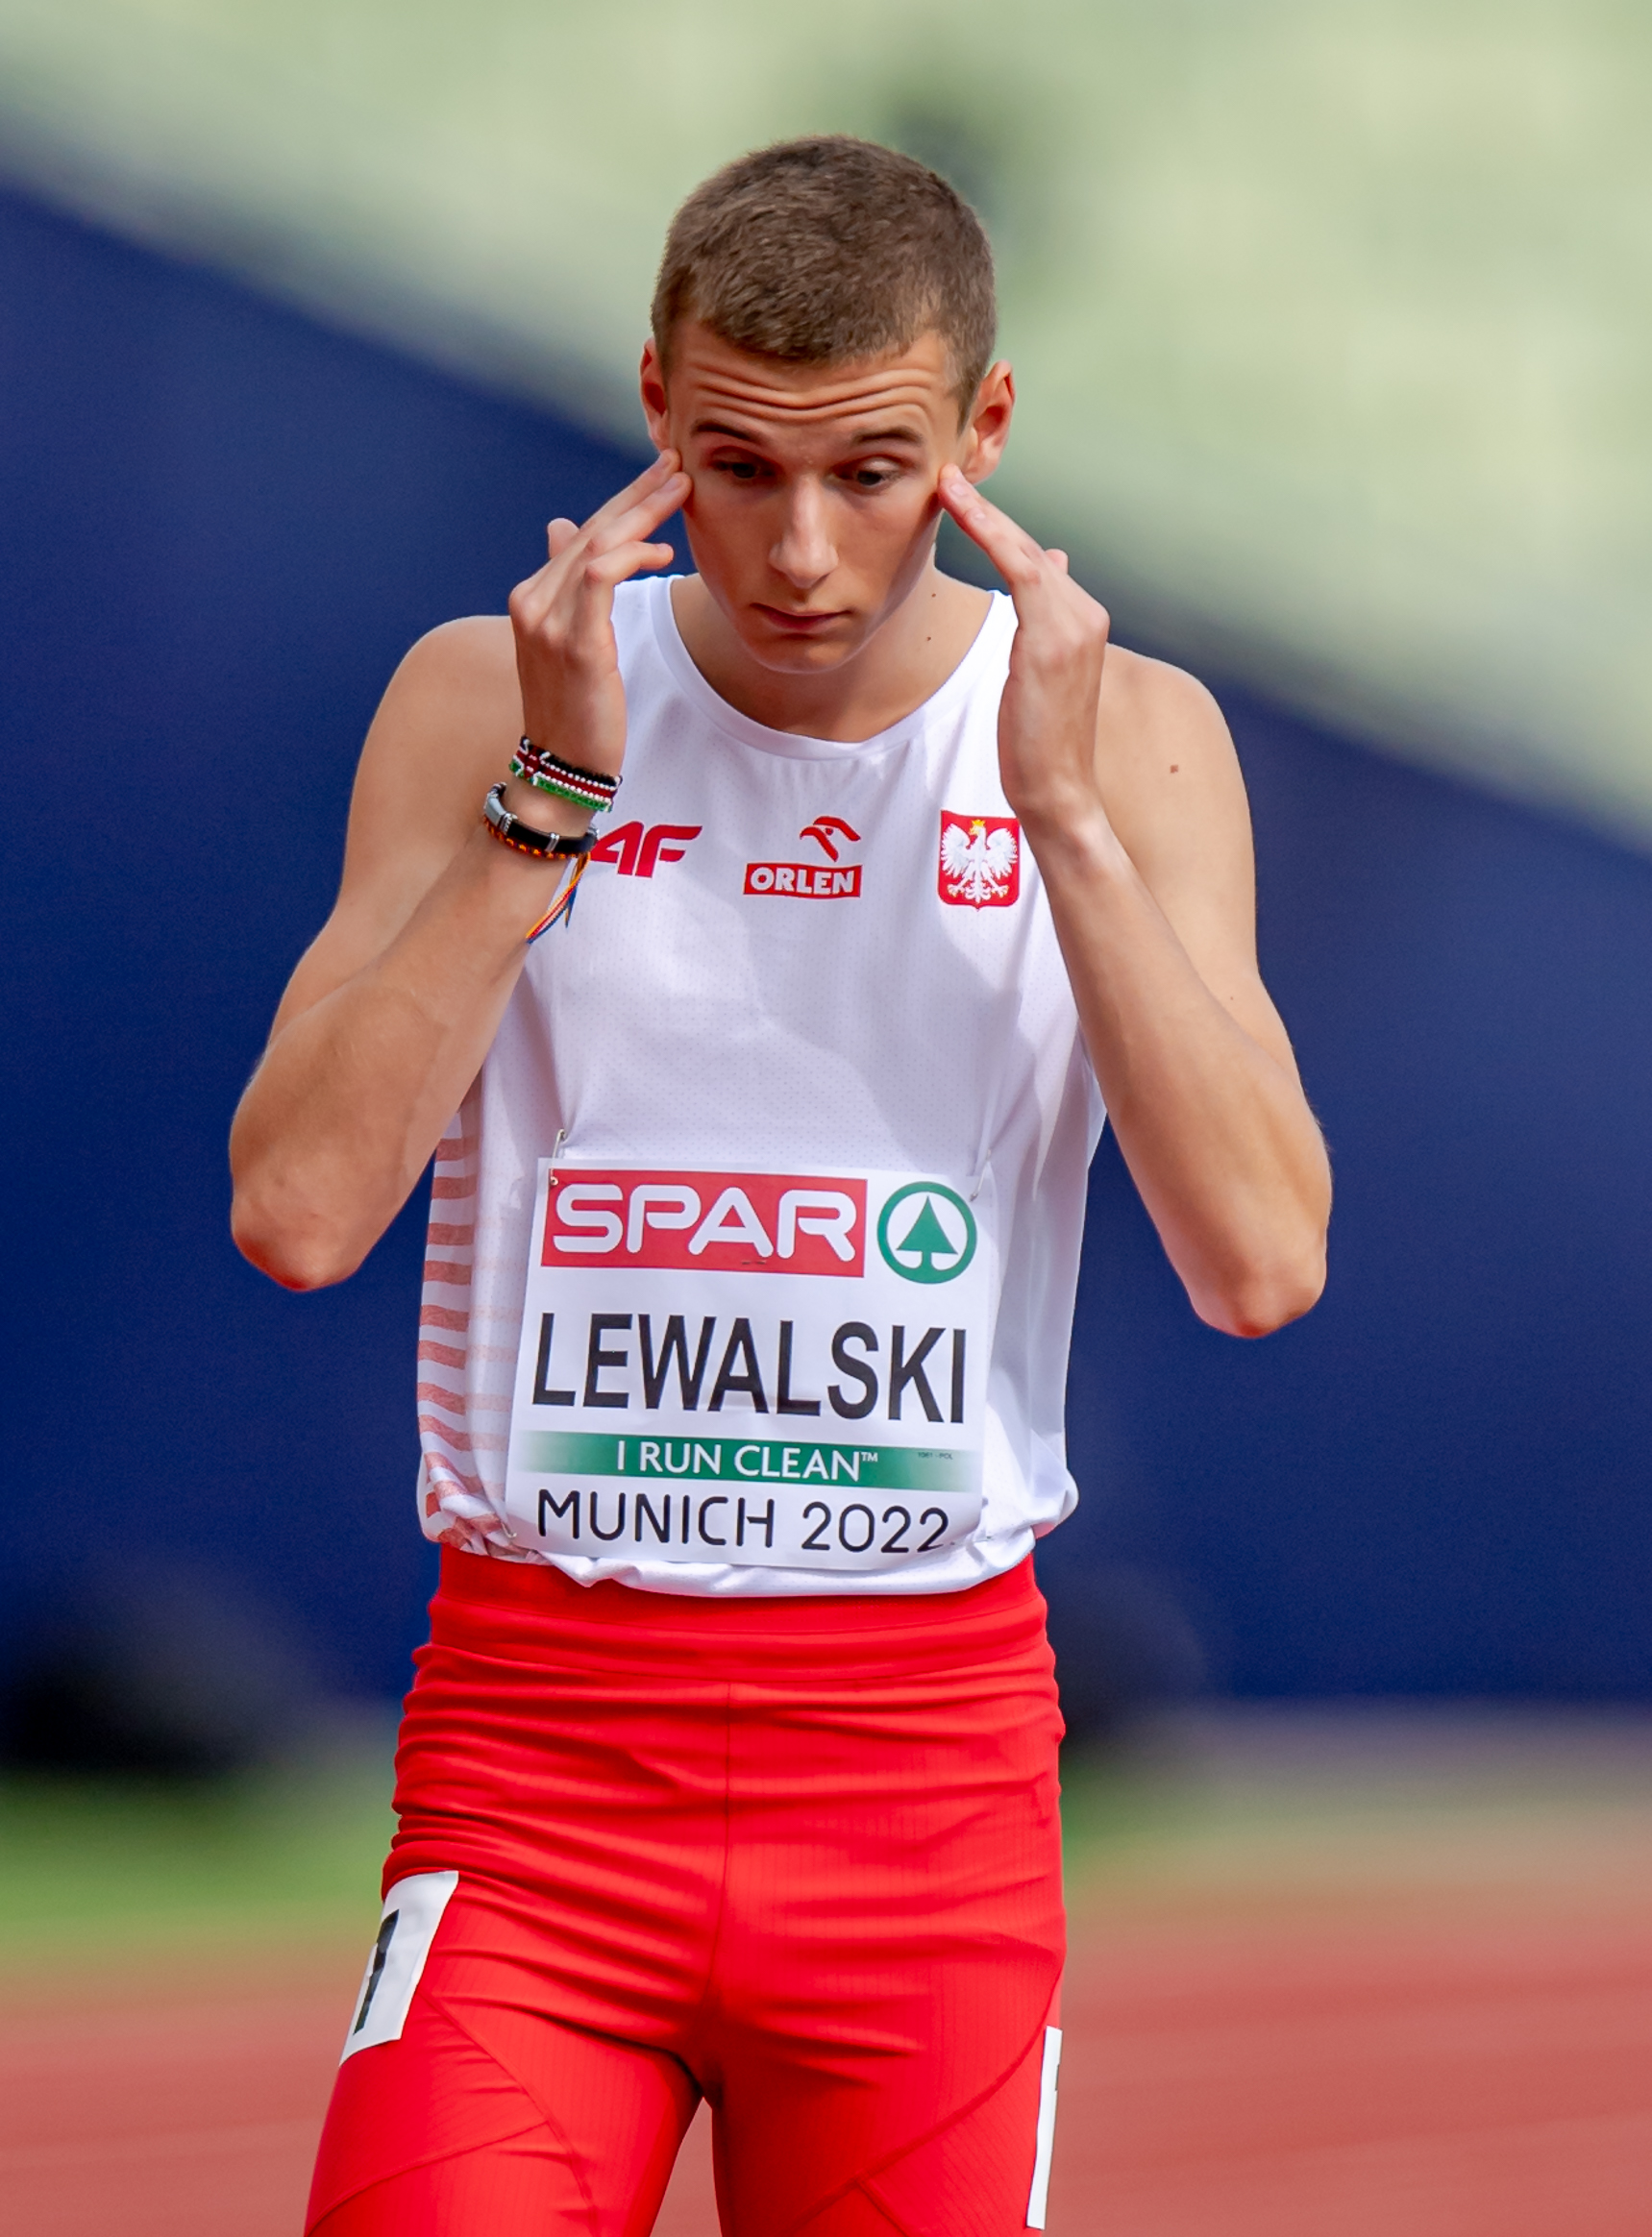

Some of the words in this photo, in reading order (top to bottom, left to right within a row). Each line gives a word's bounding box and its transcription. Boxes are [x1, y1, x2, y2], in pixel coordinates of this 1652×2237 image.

[750, 866, 855, 896] ORLEN
[553, 1183, 857, 1263] SPAR
[531, 1312, 967, 1424] LEWALSKI
[617, 1439, 626, 1471] I
[638, 1441, 722, 1475] RUN
[537, 1488, 776, 1548] MUNICH
[801, 1501, 950, 1553] 2022
